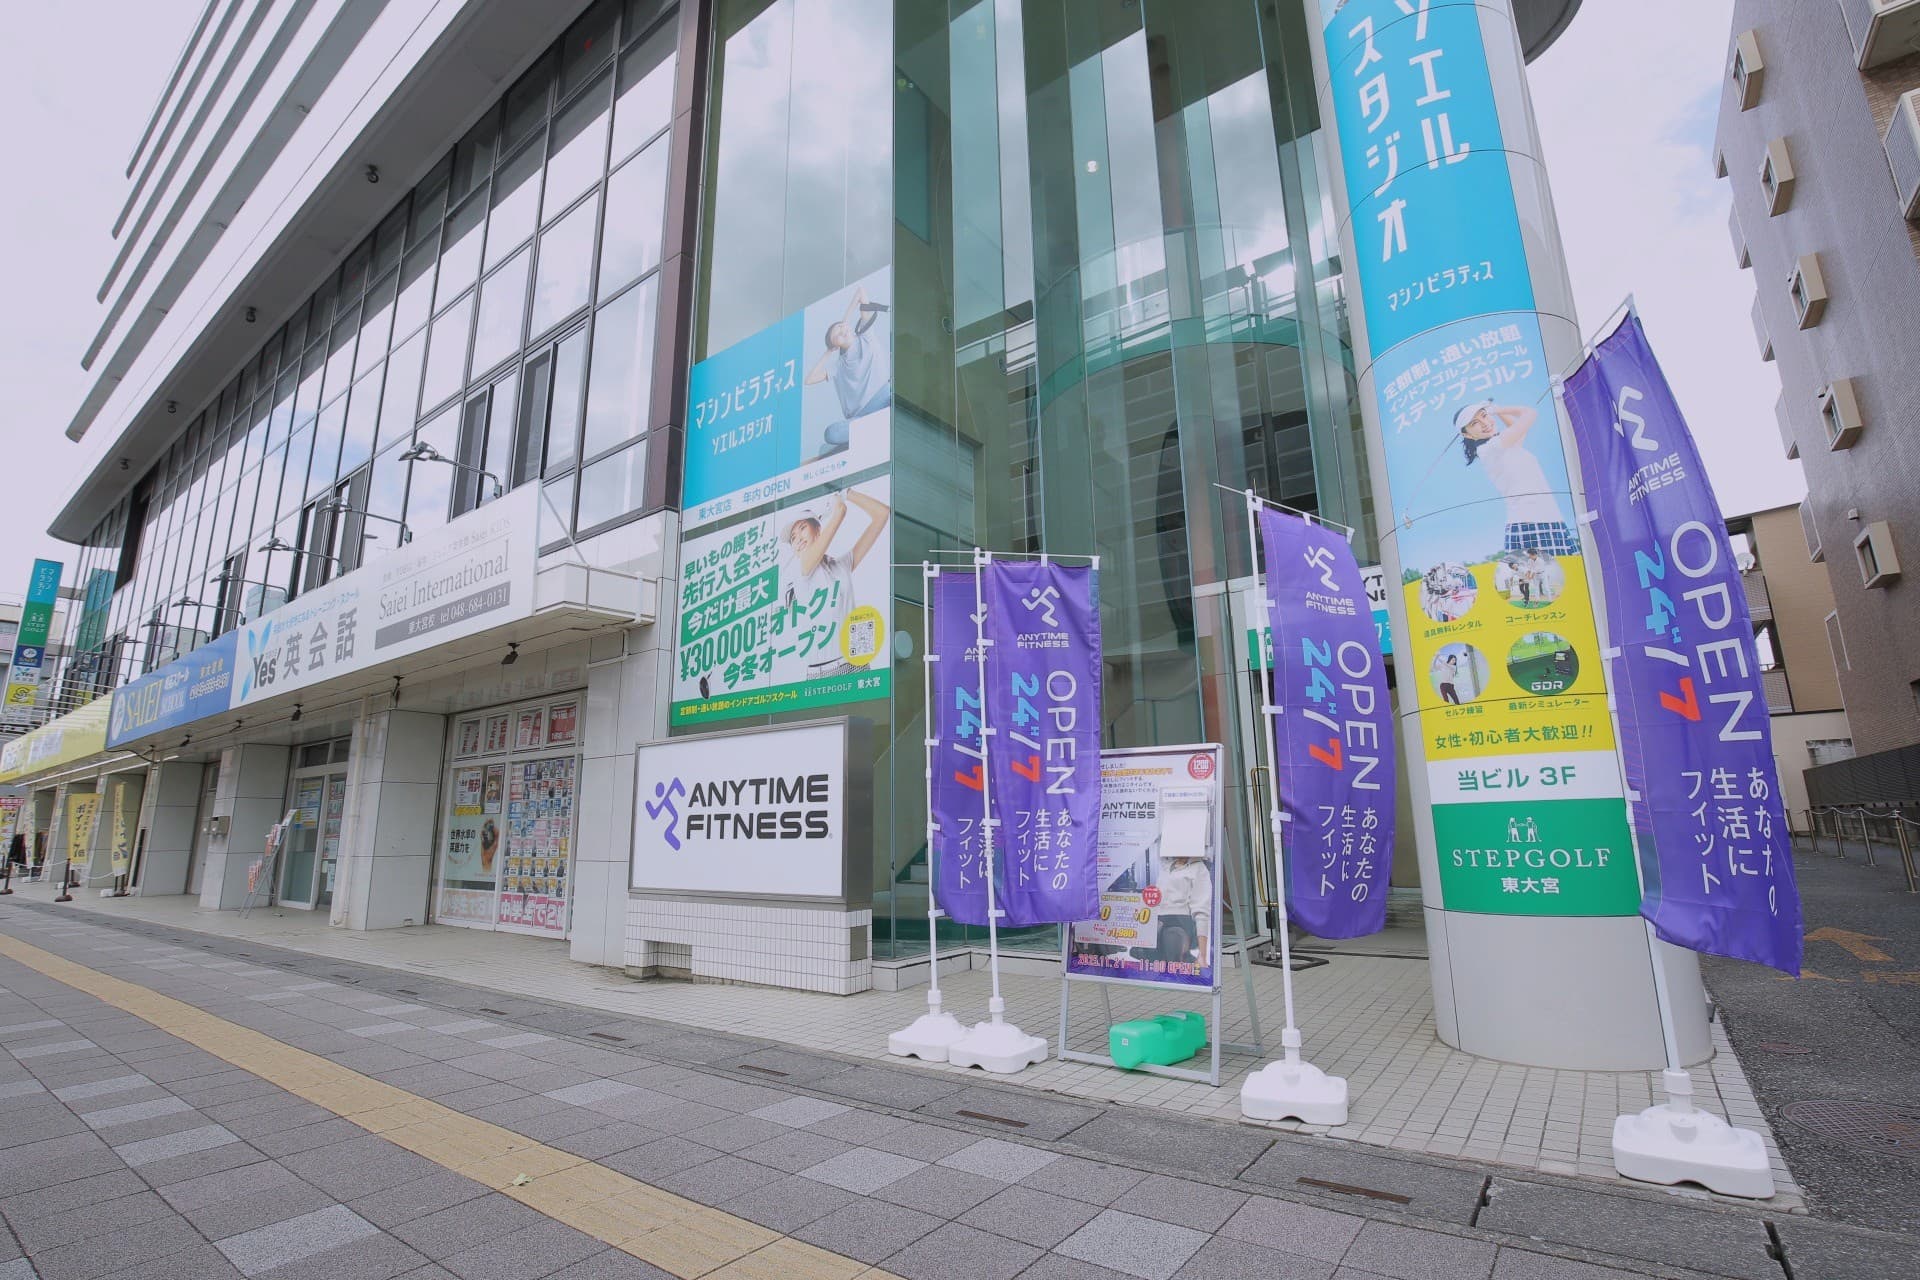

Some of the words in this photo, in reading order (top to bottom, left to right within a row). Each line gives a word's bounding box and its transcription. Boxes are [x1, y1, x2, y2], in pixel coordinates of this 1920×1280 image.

[1348, 16, 1408, 263] スタジオ
[1387, 260, 1495, 312] マシンピラティス
[695, 358, 796, 430] マシンピラティス
[1389, 343, 1528, 414] インドアゴルフスクール
[1393, 359, 1534, 434] ステップゴルフ
[699, 499, 732, 519] 東大宮店
[763, 479, 791, 498] OPEN
[1627, 452, 1682, 493] ANYTIME
[1629, 466, 1687, 506] FITNESS
[378, 586, 408, 620] Saiei
[412, 539, 510, 607] International
[682, 552, 751, 610] 先行入会
[687, 576, 769, 636] 今だけ最大
[1305, 591, 1355, 607] ANYTIME
[770, 580, 840, 636] オトク!
[1305, 600, 1357, 616] FITNESS
[1505, 611, 1567, 624] コーチレッスン
[1670, 520, 1763, 742] OPEN
[282, 606, 358, 680] 英会話
[723, 622, 837, 690] 今冬オープン
[1016, 632, 1069, 642] ANYTIME
[1017, 640, 1070, 649] FITNESS
[123, 679, 163, 732] SAIEI
[857, 677, 881, 690] 東大宮
[1509, 698, 1590, 711] 最新シミュレーター
[1531, 680, 1565, 691] GDR
[1046, 670, 1077, 794] OPEN
[1337, 640, 1381, 791] OPEN
[687, 774, 829, 808] ANYTIME
[1102, 801, 1156, 810] ANYTIME
[1458, 768, 1530, 791] 当ビル
[1540, 766, 1576, 786] 3F
[450, 829, 476, 840] 世界水準の
[686, 810, 829, 840] FITNESS
[1033, 808, 1052, 873] 生活に
[1101, 811, 1156, 819] FITNESS
[1340, 804, 1357, 882] 生活に
[1681, 770, 1721, 895] フィット
[1710, 766, 1759, 876] 生活に
[957, 818, 974, 890] フィット
[1015, 810, 1032, 887] フィット
[1052, 808, 1073, 890] あなたの
[1318, 805, 1338, 897] フィット
[1351, 806, 1379, 903] あなたの
[1453, 848, 1611, 868] STEPGOLF
[1501, 877, 1560, 894] 東大宮
